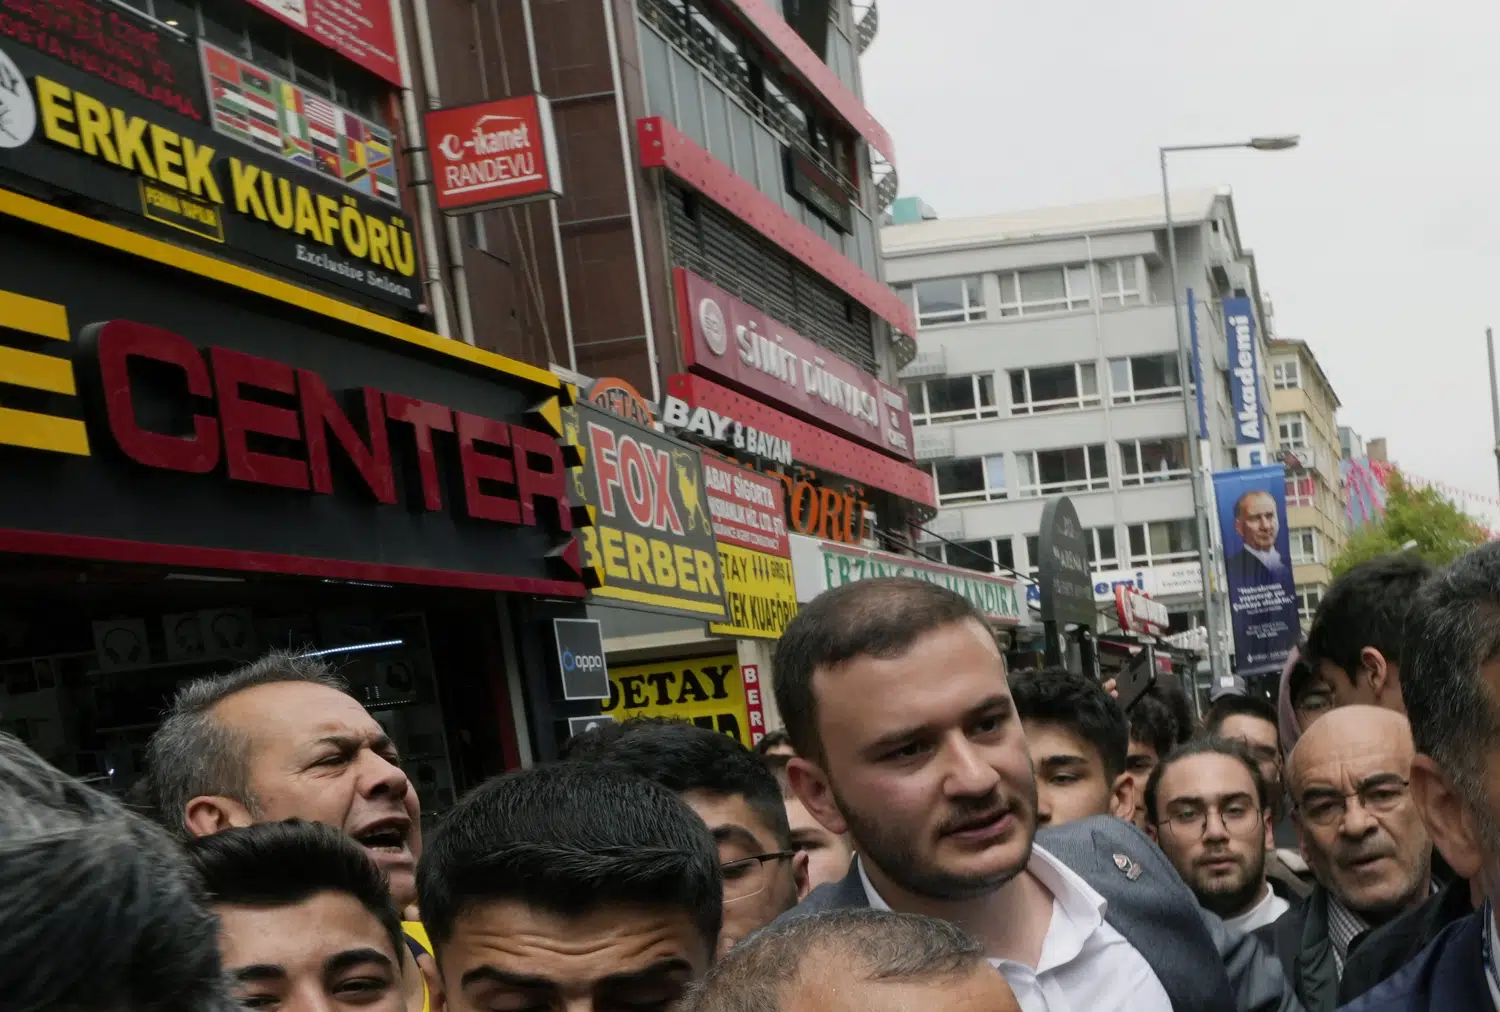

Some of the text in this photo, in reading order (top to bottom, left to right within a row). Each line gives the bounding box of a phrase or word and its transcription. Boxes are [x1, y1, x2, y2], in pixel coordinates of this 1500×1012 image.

[34, 75, 416, 278] ERKEK KUAFÖRÜ
[438, 122, 531, 161] e-ikamet
[445, 151, 535, 189] RANDEVU
[295, 243, 412, 299] Exclusive Saloon
[1228, 315, 1260, 439] Akademi
[97, 319, 573, 533] CENTER
[662, 395, 792, 466] BAY & BAYAN
[587, 420, 685, 537] FOX
[582, 525, 721, 597] BERBER
